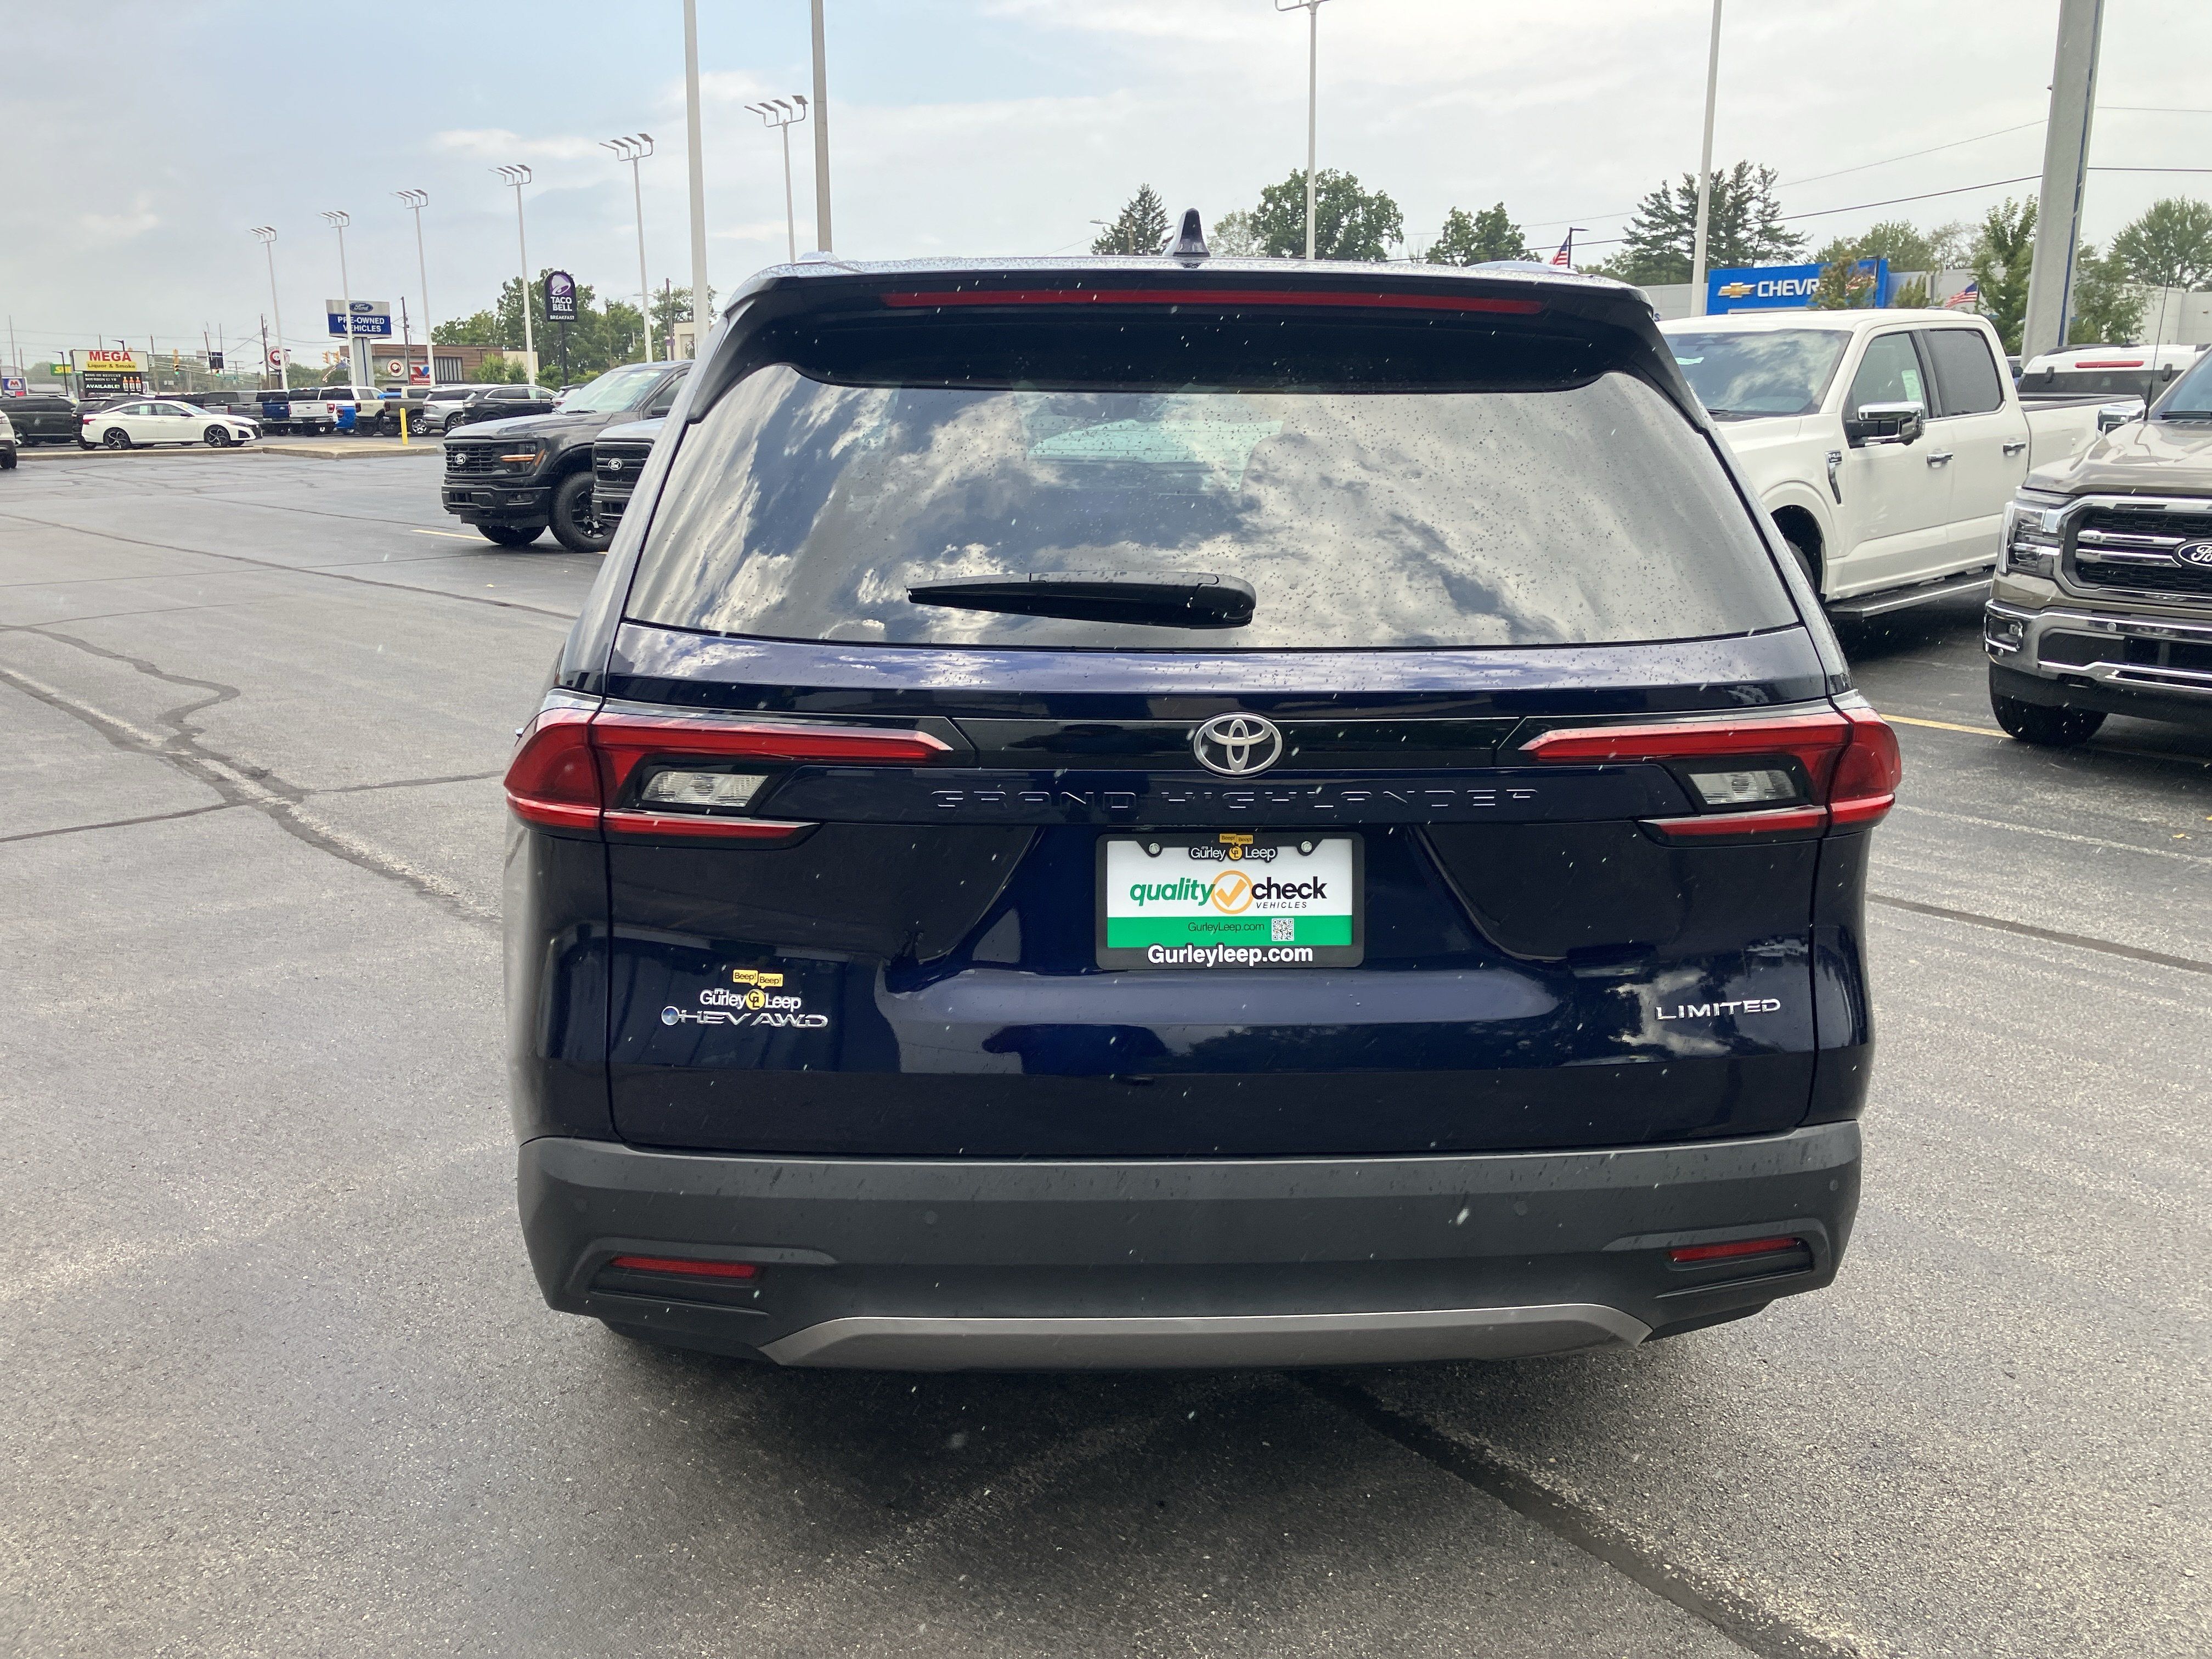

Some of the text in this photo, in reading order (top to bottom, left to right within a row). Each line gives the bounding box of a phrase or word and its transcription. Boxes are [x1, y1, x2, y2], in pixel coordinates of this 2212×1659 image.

[1757, 278, 1822, 297] CHEVR
[89, 351, 132, 362] MEGA
[2191, 545, 2212, 562] Fo
[930, 790, 1137, 811] GRAND
[1190, 847, 1226, 861] Gurley
[1245, 846, 1276, 861] Leep
[1130, 876, 1328, 906] quality check
[1188, 922, 1265, 932] GurleyLeep.com
[1147, 944, 1313, 967] Gurleyleep.com
[735, 972, 782, 985] Beep! Beep!
[699, 989, 747, 1010] Gurley
[764, 992, 802, 1012] Leep
[1655, 998, 1781, 1020] LIMITED
[750, 1012, 828, 1028] AWD
